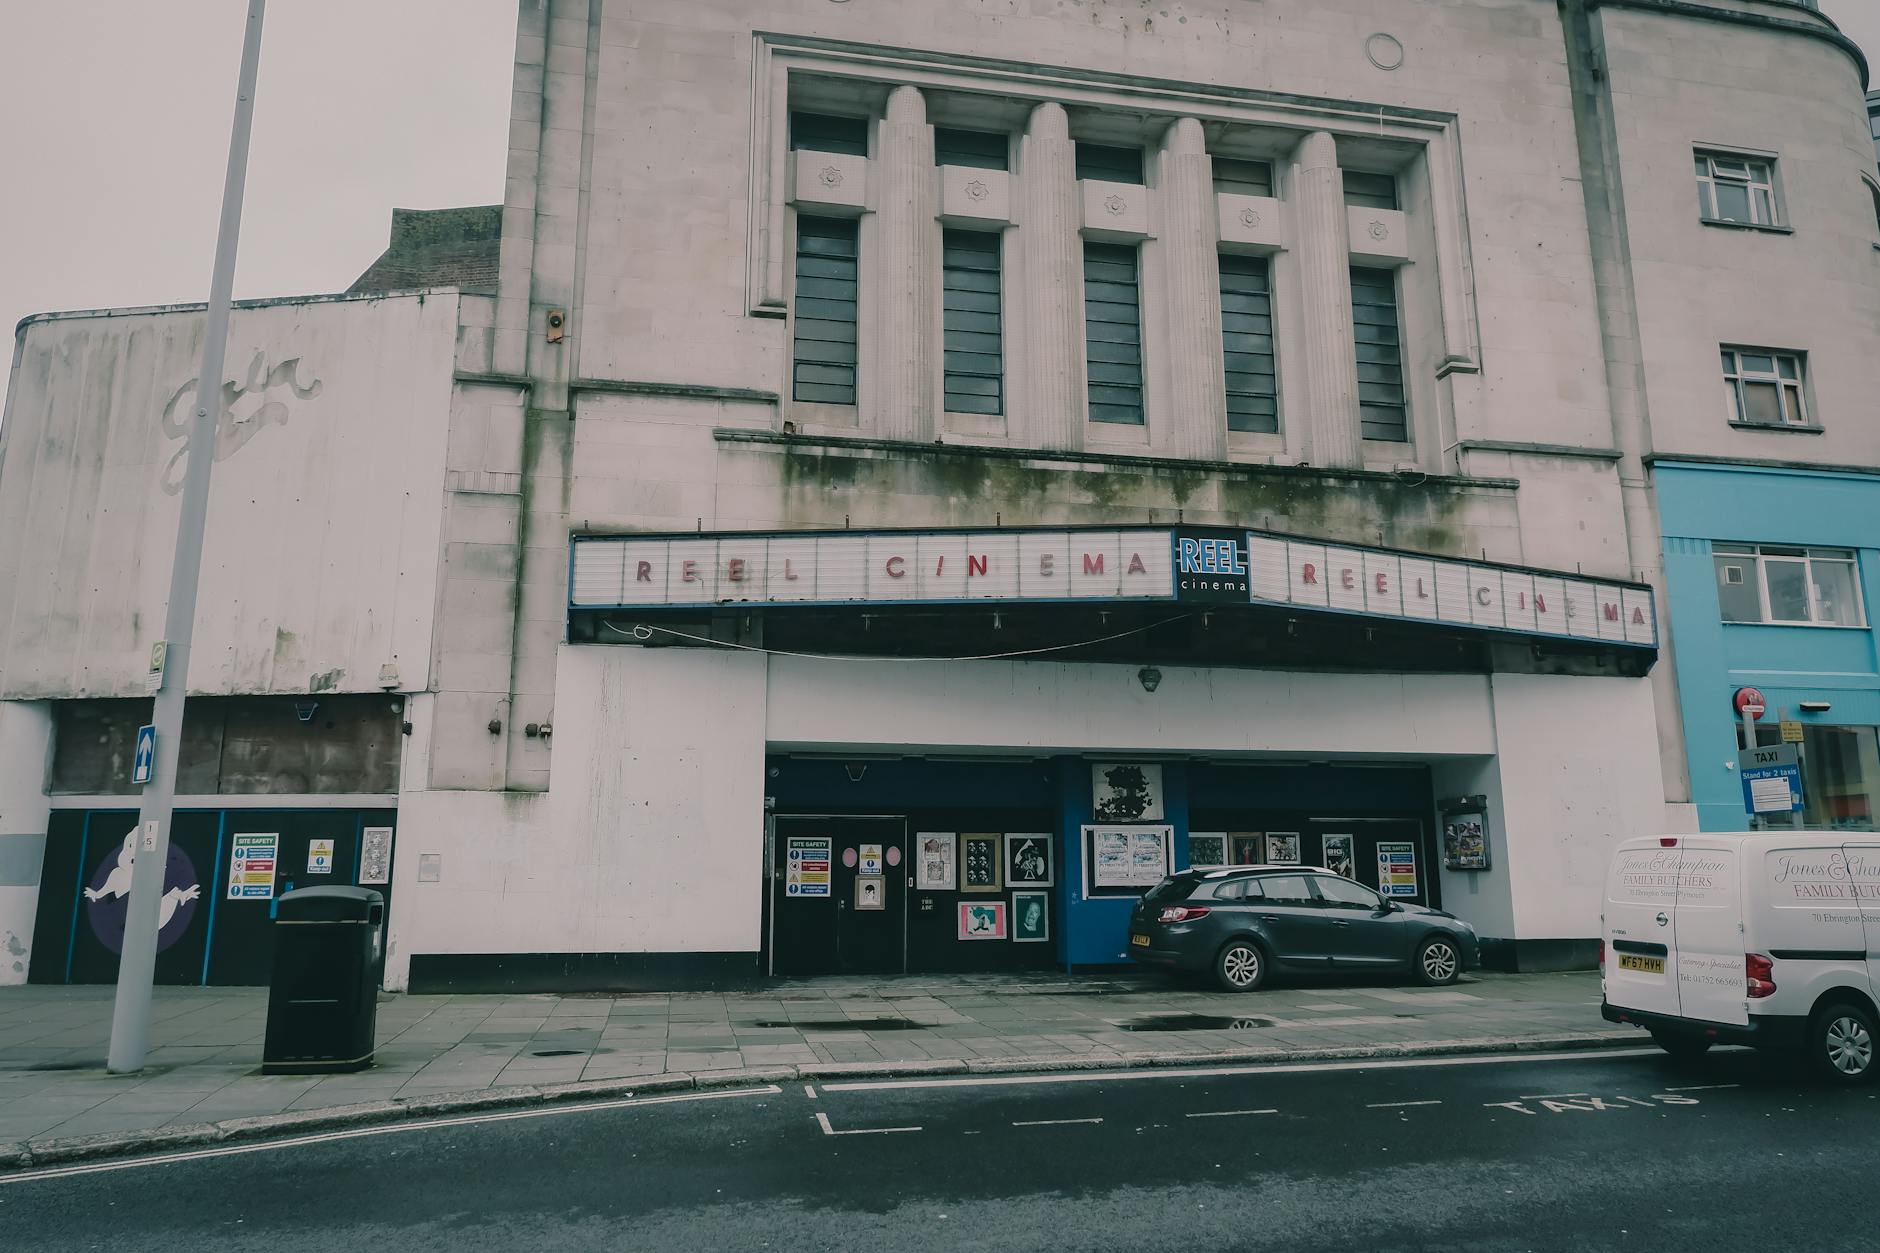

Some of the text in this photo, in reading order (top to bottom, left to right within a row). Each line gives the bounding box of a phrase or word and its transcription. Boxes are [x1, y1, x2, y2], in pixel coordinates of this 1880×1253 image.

[1178, 537, 1246, 576] REEL
[635, 552, 1148, 583] REEL CINEMA
[1180, 578, 1248, 592] cinema
[1302, 562, 1647, 626] REEL CINEMA
[1754, 752, 1778, 763] TAXI
[1742, 768, 1797, 779] Stand for 2 taxis
[1617, 855, 1649, 875] Jones
[1662, 854, 1728, 876] Champion
[1774, 855, 1828, 884] Jones
[1827, 853, 1848, 881] &
[1623, 875, 1713, 889] FAMILY BUTCHERS
[1794, 884, 1846, 897] FAMILY
[1811, 912, 1823, 923] 70
[1823, 913, 1861, 925] Ebrington
[1621, 955, 1662, 972] WF67 HVH
[1680, 973, 1693, 983] Tel:
[1693, 974, 1715, 985] 01752
[1482, 1093, 1701, 1116] TAXIS
